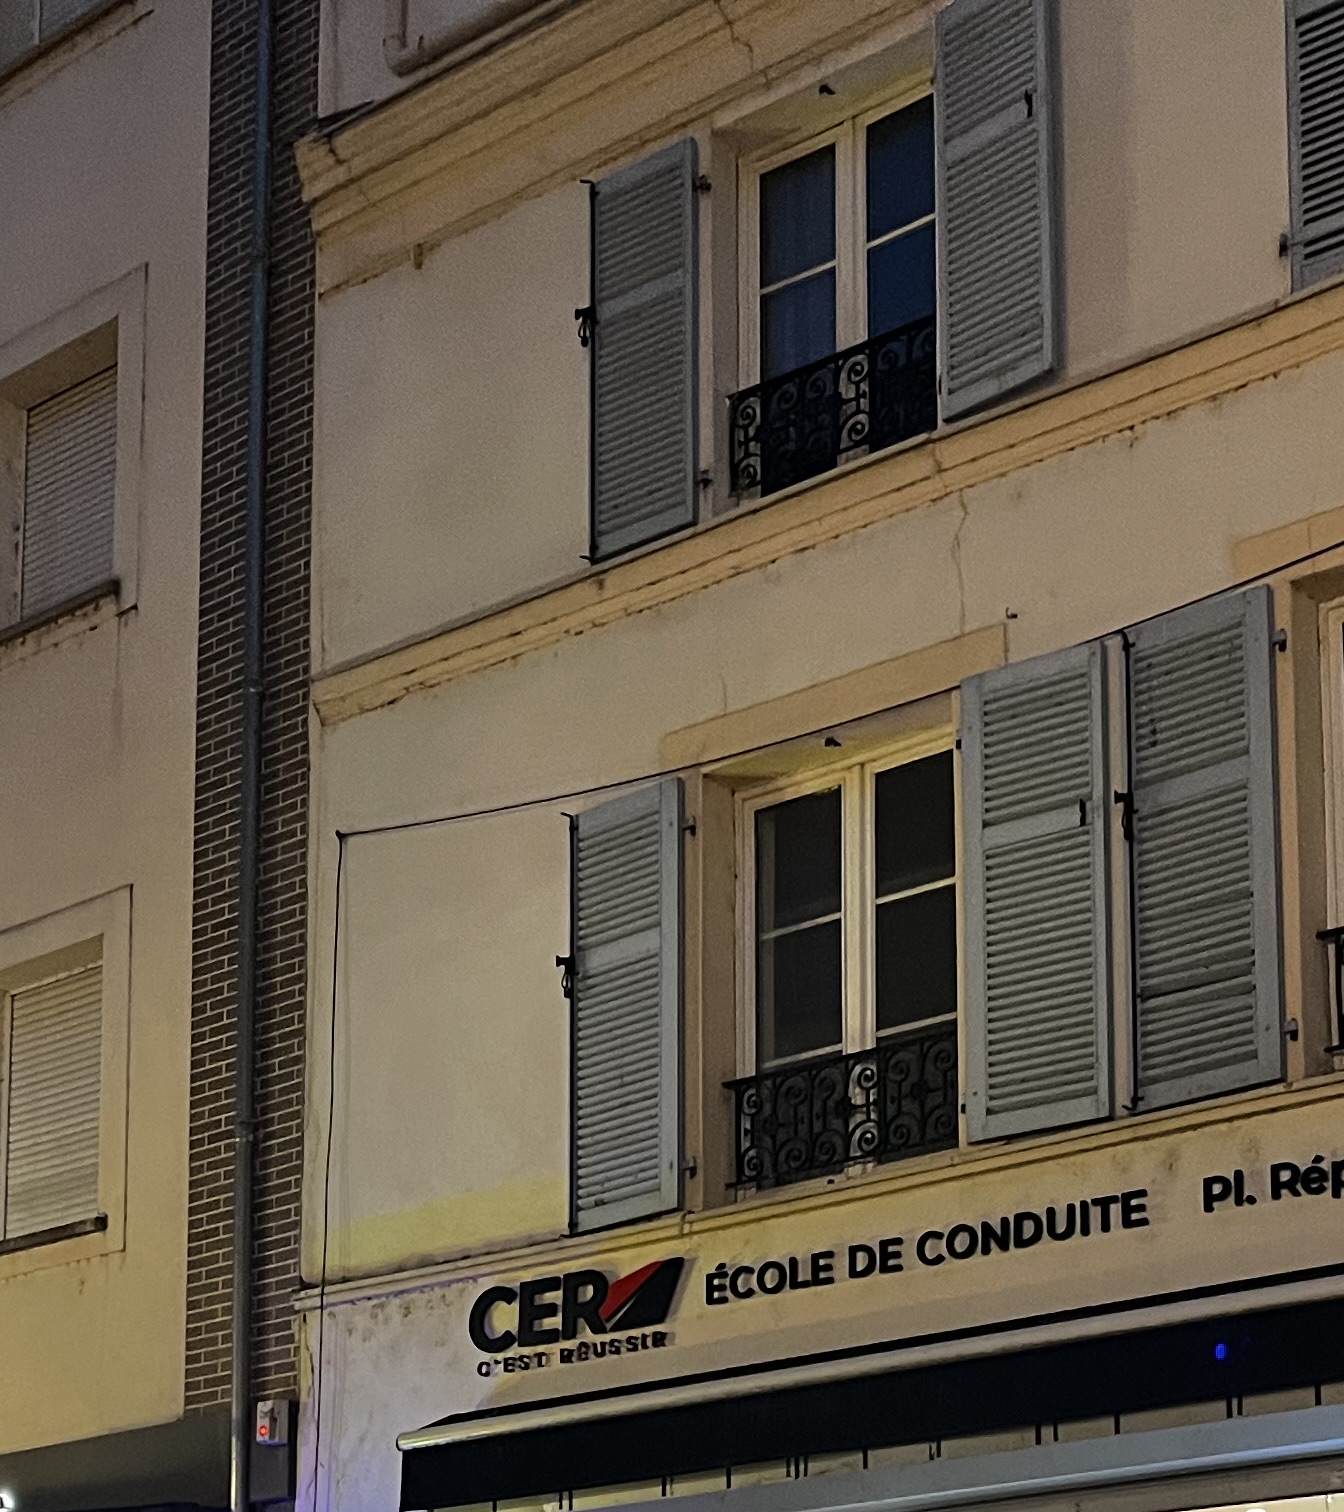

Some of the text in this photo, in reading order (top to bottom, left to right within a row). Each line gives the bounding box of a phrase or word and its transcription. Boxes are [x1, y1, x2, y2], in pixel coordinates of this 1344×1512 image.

[1202, 1169, 1258, 1214] Pl.
[705, 1188, 1150, 1306] ÉCOLE DE CONDUITE
[468, 1269, 610, 1354] CER
[476, 1331, 671, 1378] C'EST RÉUSSIR
